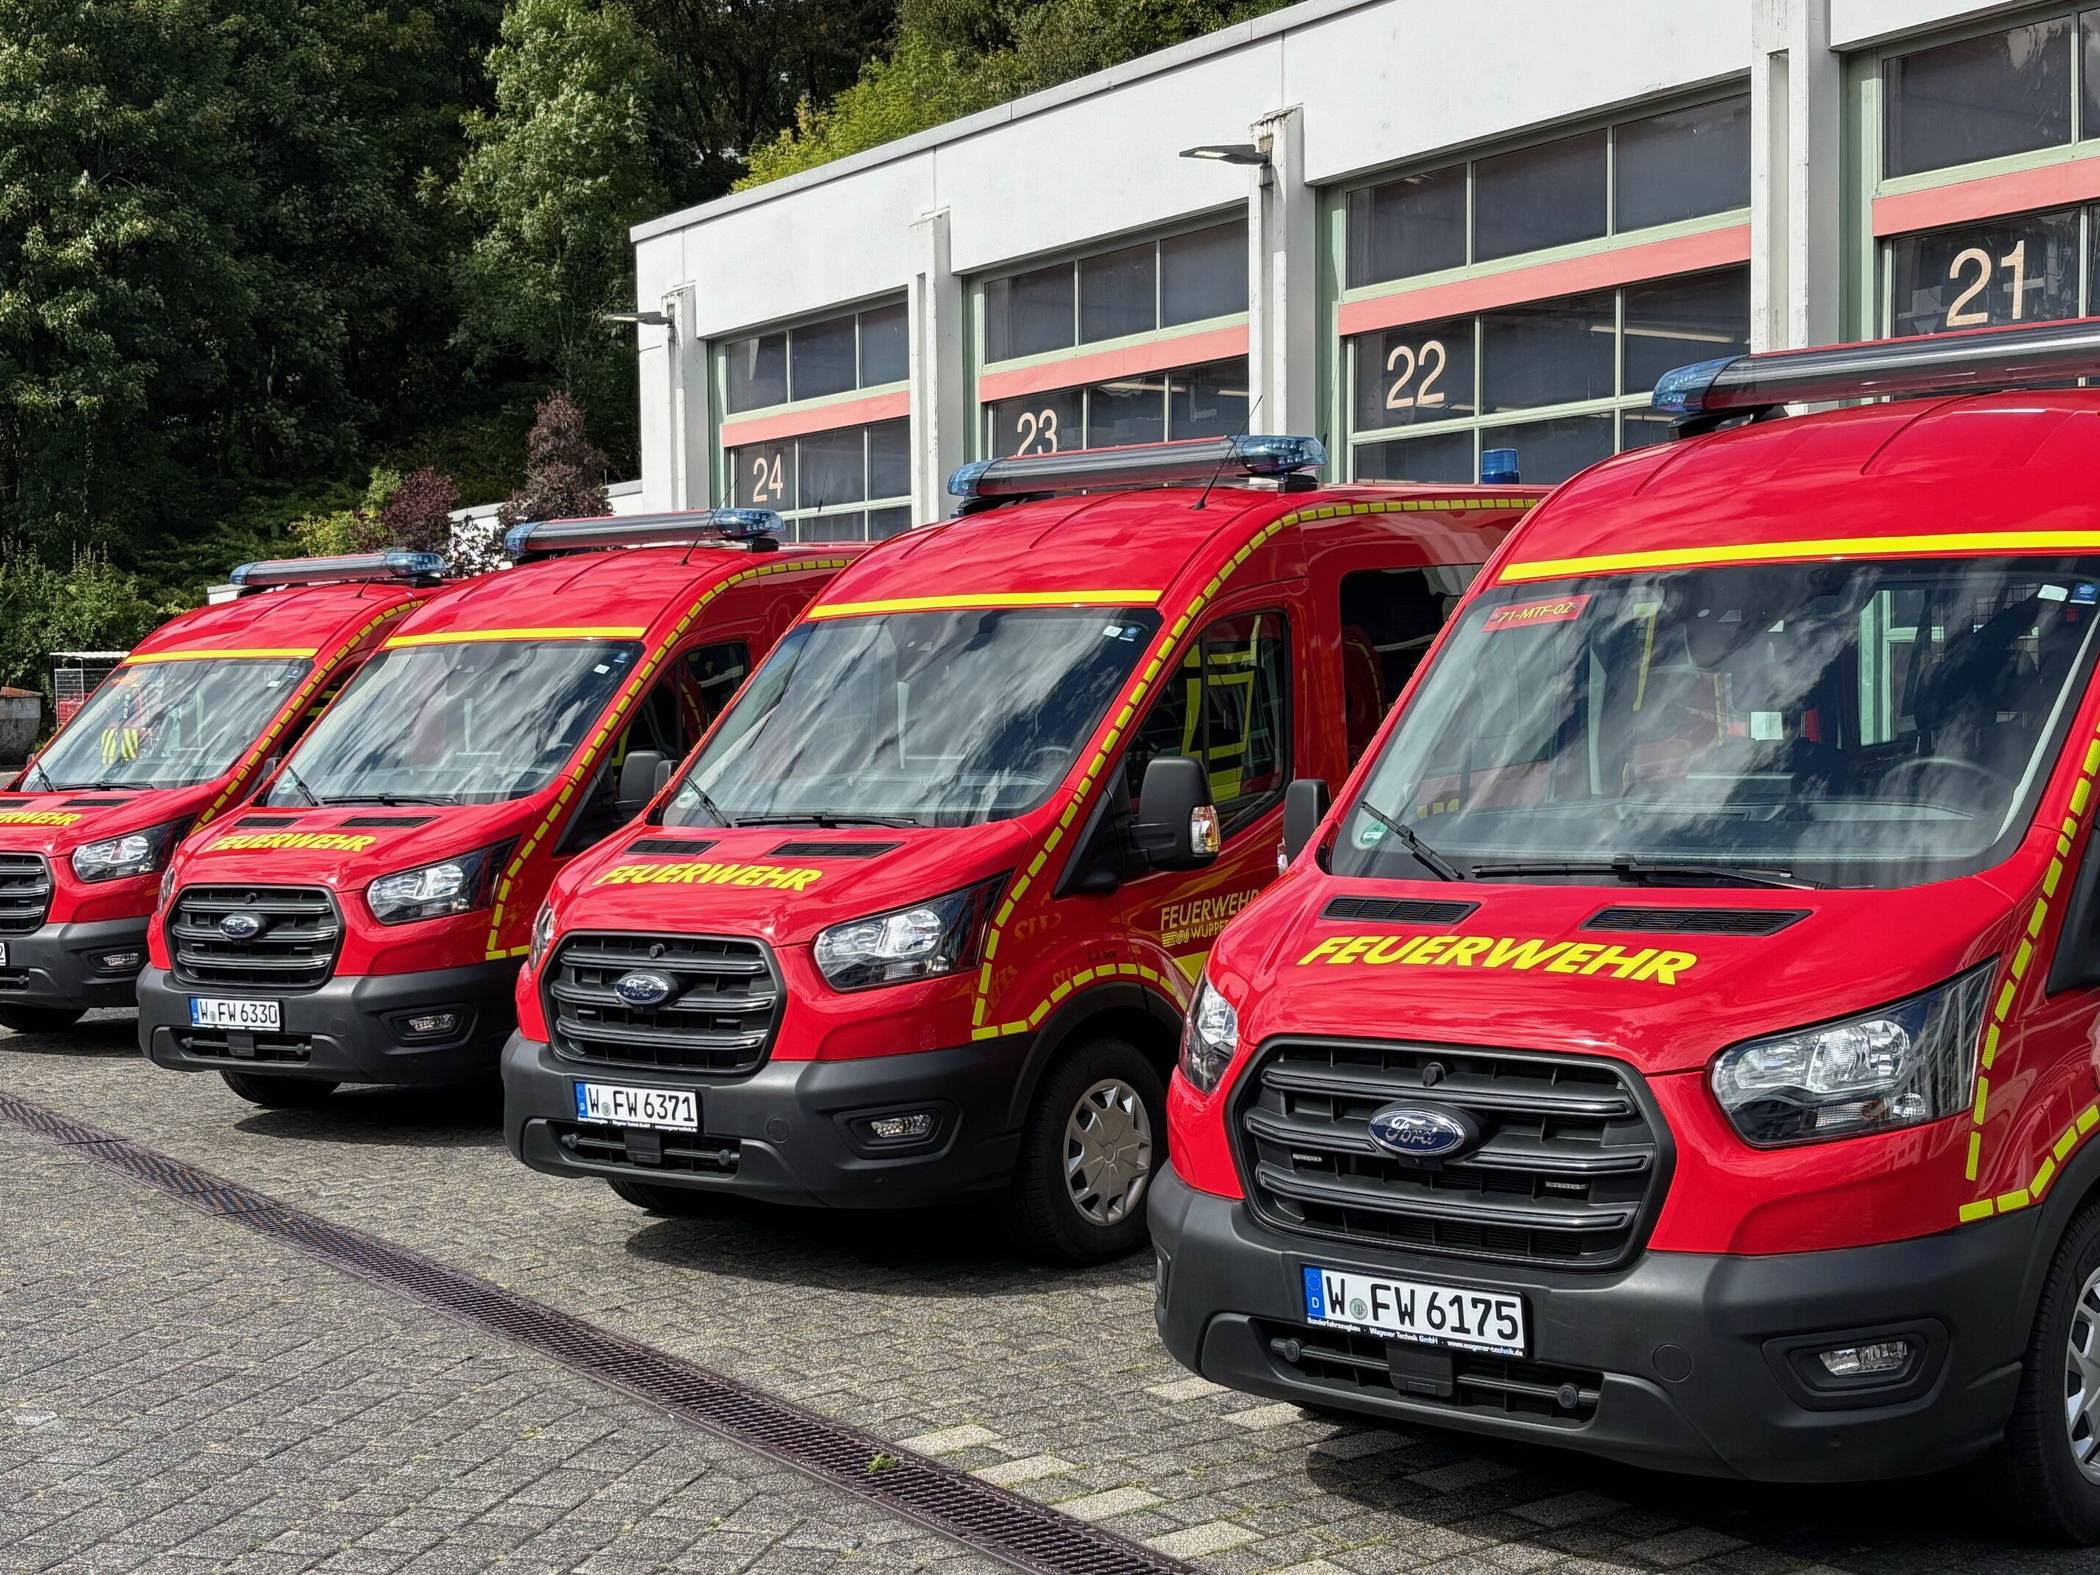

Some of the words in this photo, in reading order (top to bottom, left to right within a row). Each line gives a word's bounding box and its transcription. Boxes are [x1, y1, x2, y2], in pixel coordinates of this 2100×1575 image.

[1946, 240, 2025, 327] 21
[1386, 340, 1446, 409] 22
[1016, 409, 1058, 456] 23
[753, 453, 784, 502] 24
[0, 811, 83, 827] RWEHR
[201, 832, 377, 853] FEUERWEHR
[591, 862, 823, 892] FEUERWEHR
[1297, 934, 1698, 986] FEUERWEHR
[1385, 1116, 1439, 1146] Ford
[1325, 1276, 1346, 1316] W
